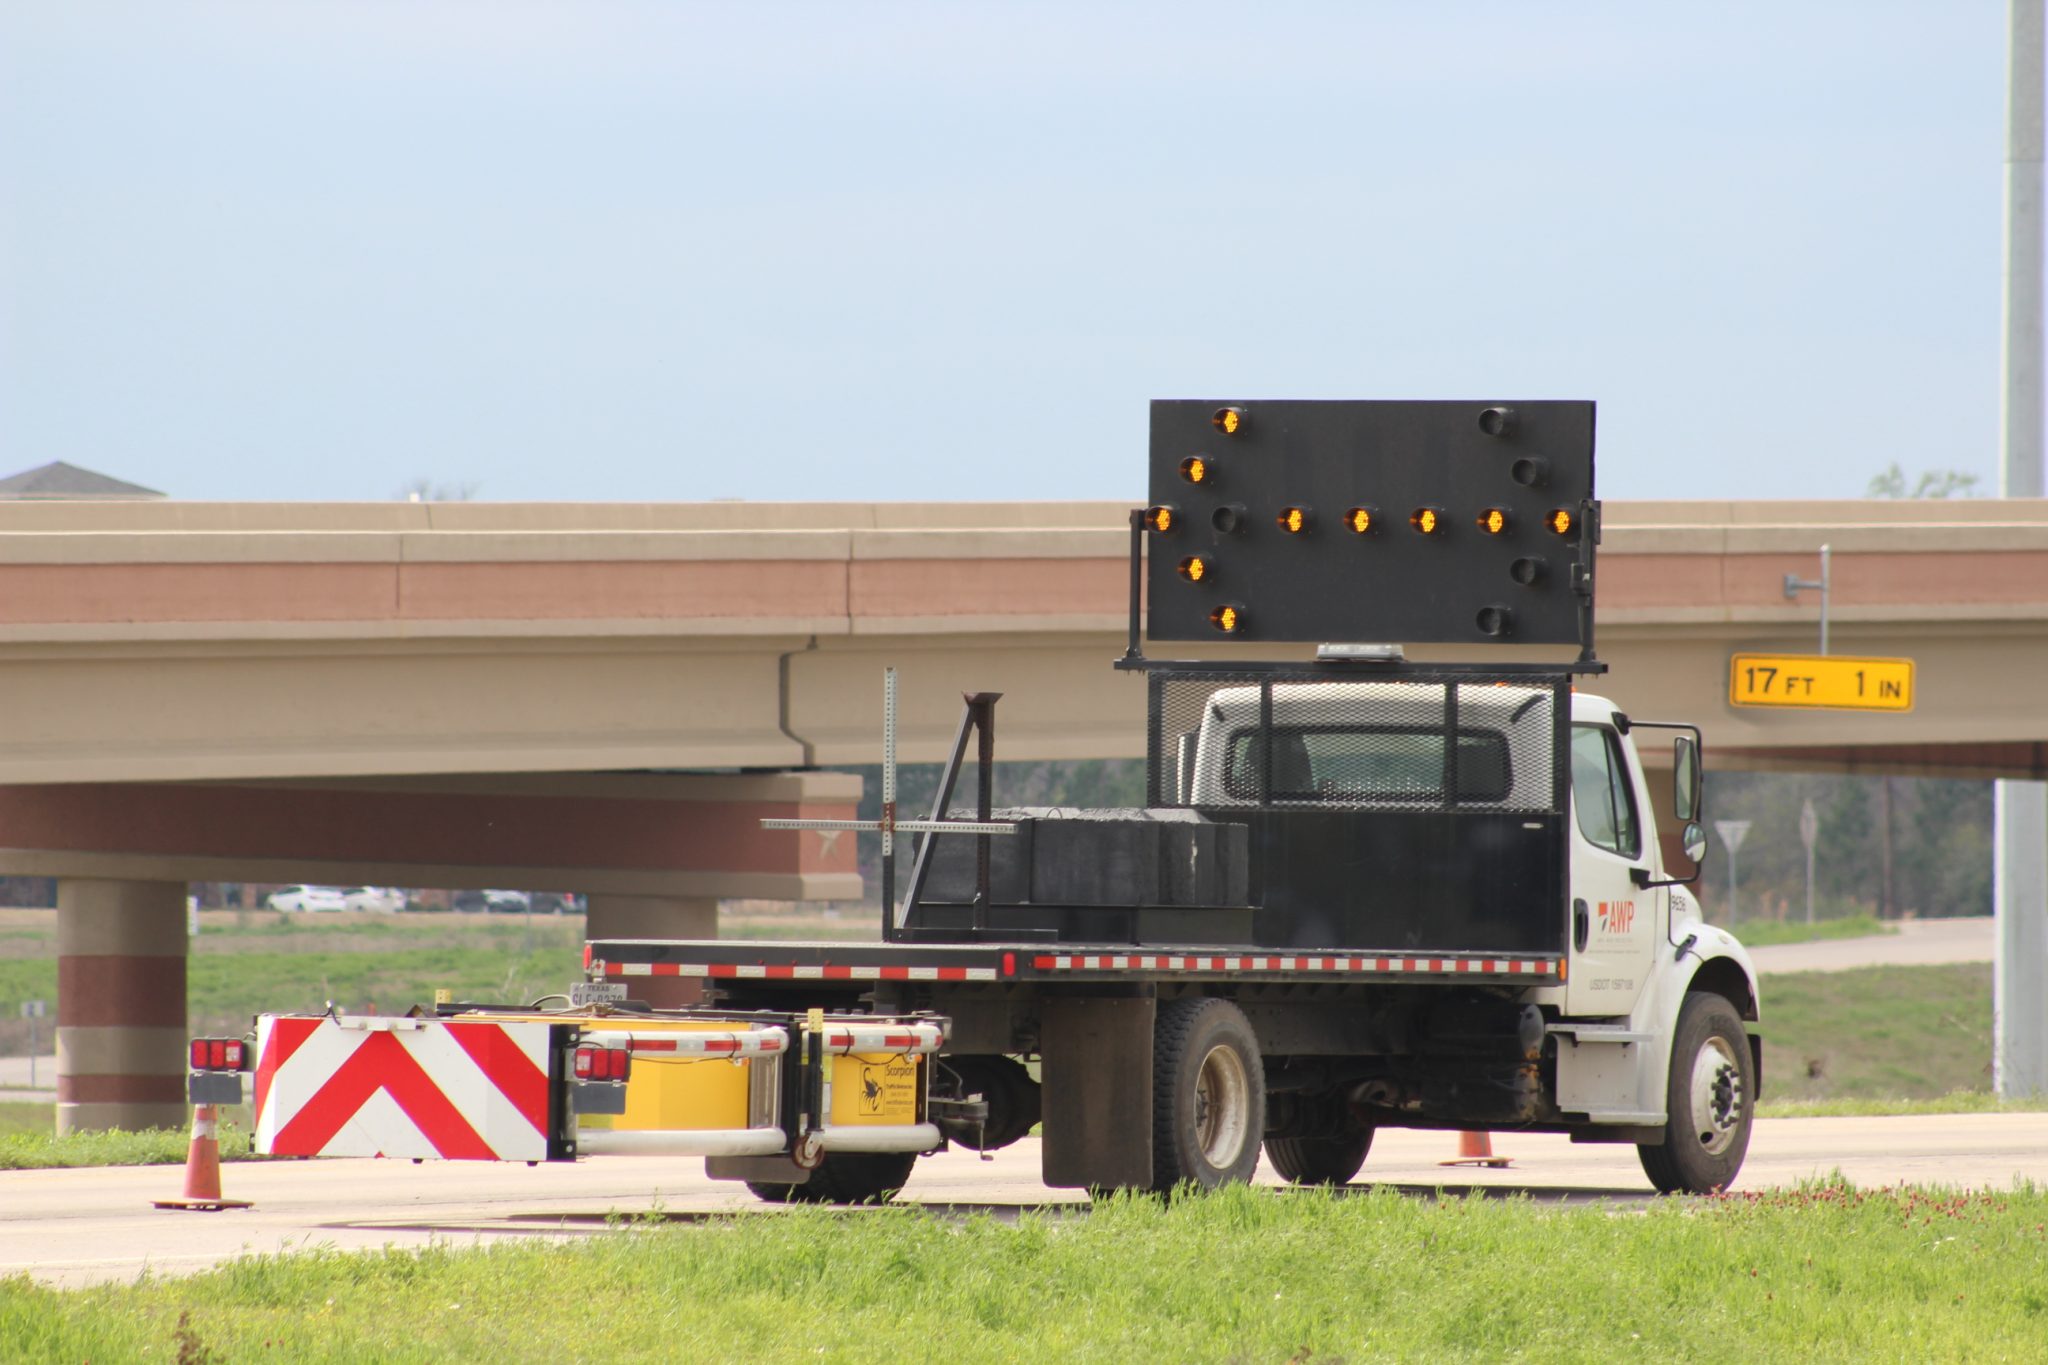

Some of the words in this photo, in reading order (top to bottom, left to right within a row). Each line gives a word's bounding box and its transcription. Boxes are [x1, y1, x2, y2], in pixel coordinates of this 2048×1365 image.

[1746, 667, 1778, 694] 17
[1786, 677, 1815, 696] FT
[1856, 670, 1864, 697] 1
[1879, 680, 1902, 698] IN
[1608, 900, 1635, 934] AWP
[588, 985, 610, 993] TEXAS
[885, 1064, 914, 1079] Scorpion
